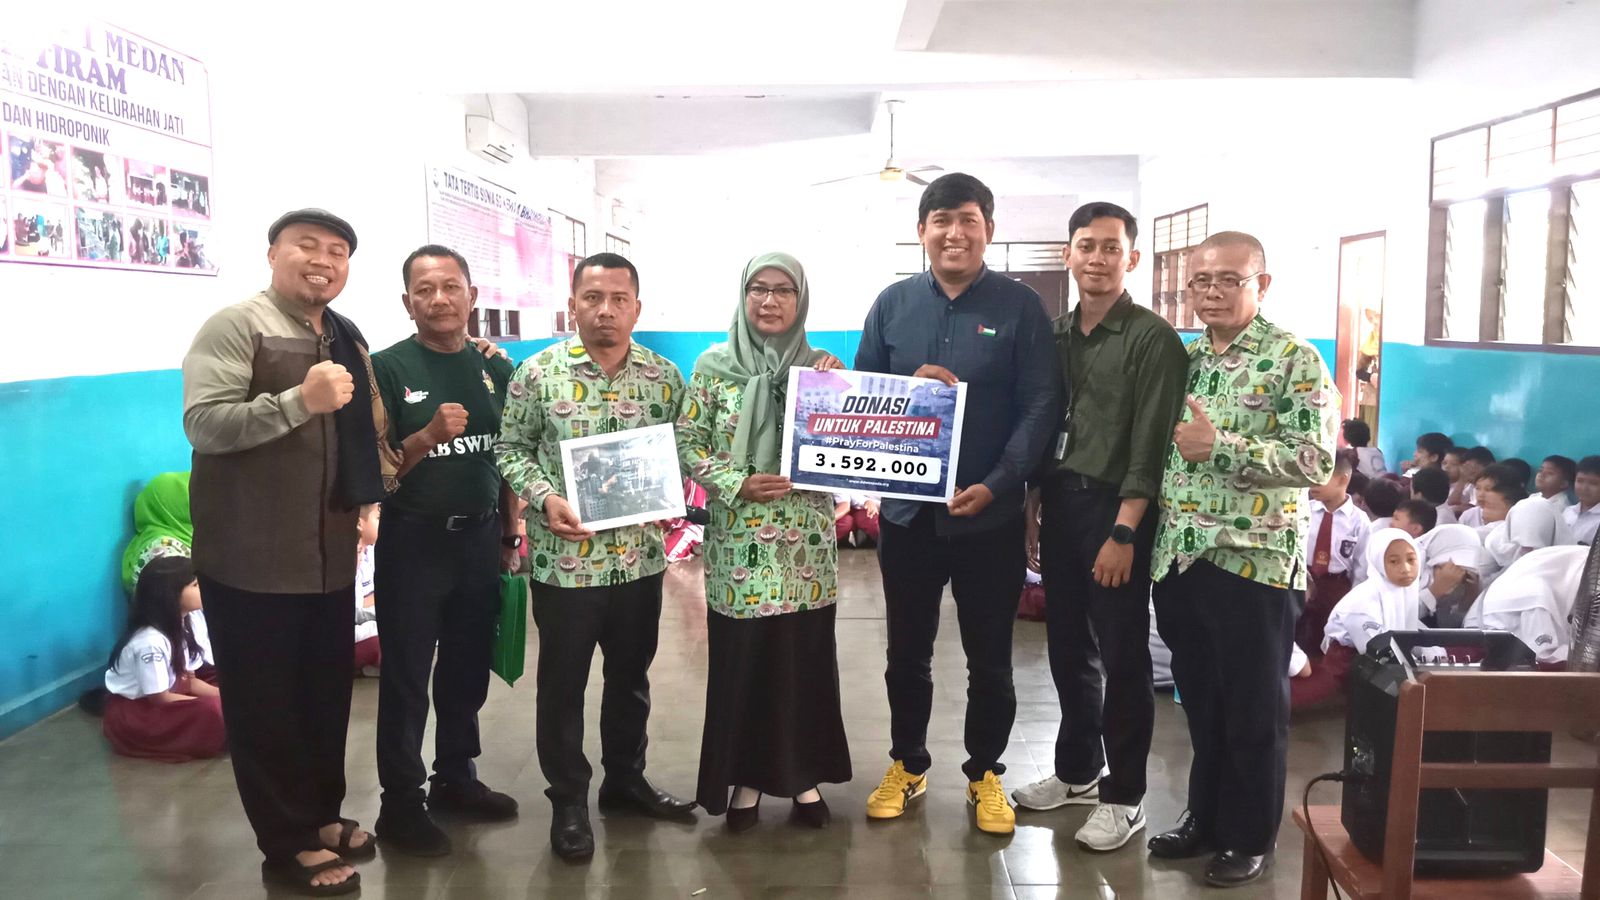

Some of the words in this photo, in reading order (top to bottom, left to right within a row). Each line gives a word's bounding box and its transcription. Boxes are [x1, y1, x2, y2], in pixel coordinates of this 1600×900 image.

[105, 30, 185, 85] MEDAN
[28, 70, 86, 108] DENGAN
[89, 90, 160, 129] KELURAHAN
[163, 113, 184, 135] JATI
[2, 101, 32, 127] DAN
[35, 110, 110, 146] HIDROPONIK
[443, 171, 459, 192] TATA
[460, 178, 479, 200] TERTIB
[842, 395, 911, 415] DONASI
[813, 417, 862, 433] UNTUK
[863, 420, 936, 436] PALESTINA
[825, 437, 919, 453] #PrayForPalestina
[815, 453, 928, 476] 3.592.000
